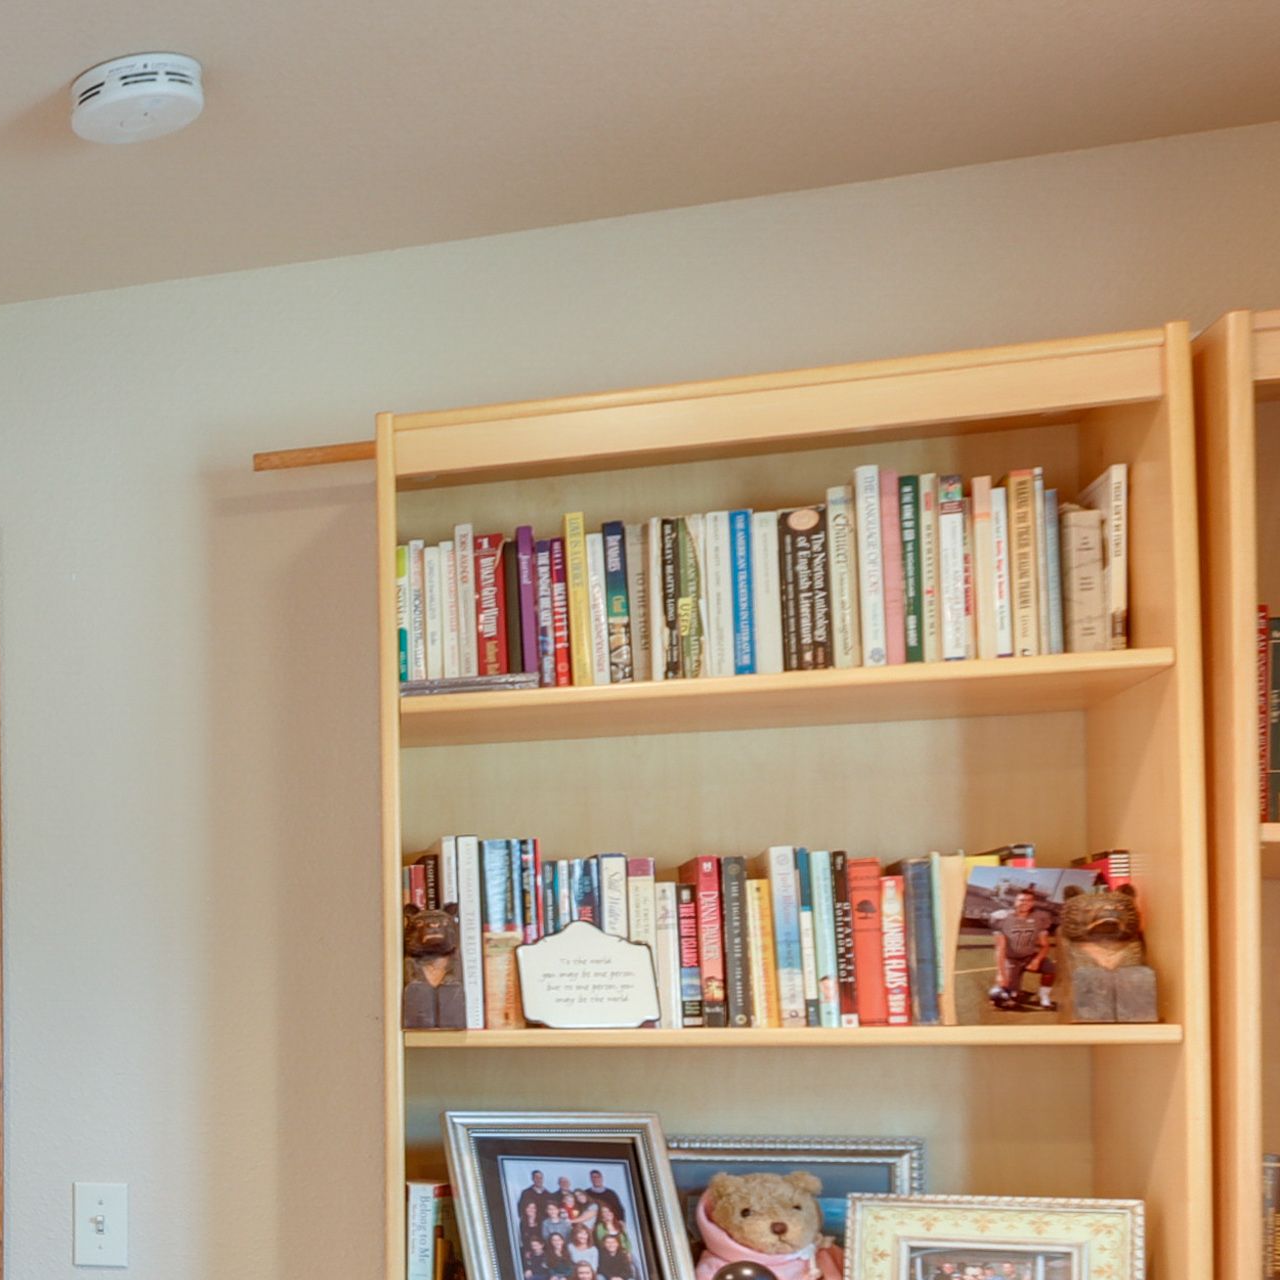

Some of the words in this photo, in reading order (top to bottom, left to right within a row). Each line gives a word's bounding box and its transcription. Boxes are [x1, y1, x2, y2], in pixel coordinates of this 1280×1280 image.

[796, 536, 810, 548] of
[811, 531, 825, 552] The
[519, 552, 531, 585] Journal
[635, 572, 646, 585] TO
[796, 550, 811, 589] English
[812, 553, 826, 588] Norton
[637, 588, 647, 608] THE
[800, 592, 813, 644] Literature
[813, 589, 828, 643] Anthology
[731, 881, 739, 897] THE
[465, 911, 477, 931] THE
[679, 903, 696, 917] THE
[699, 891, 718, 923] DIANA
[731, 901, 741, 934] TIGER'S
[702, 924, 720, 960] PALMER
[835, 903, 846, 954] MORRISON
[843, 902, 855, 983] BELOVED
[883, 915, 906, 956] SANIBEL
[682, 938, 698, 967] ISLANDS
[733, 937, 741, 958] WIFE
[839, 958, 847, 983] TONI
[885, 959, 907, 988] FLATS
[417, 1195, 431, 1231] Belong
[419, 1234, 429, 1245] to
[419, 1247, 429, 1264] Me
